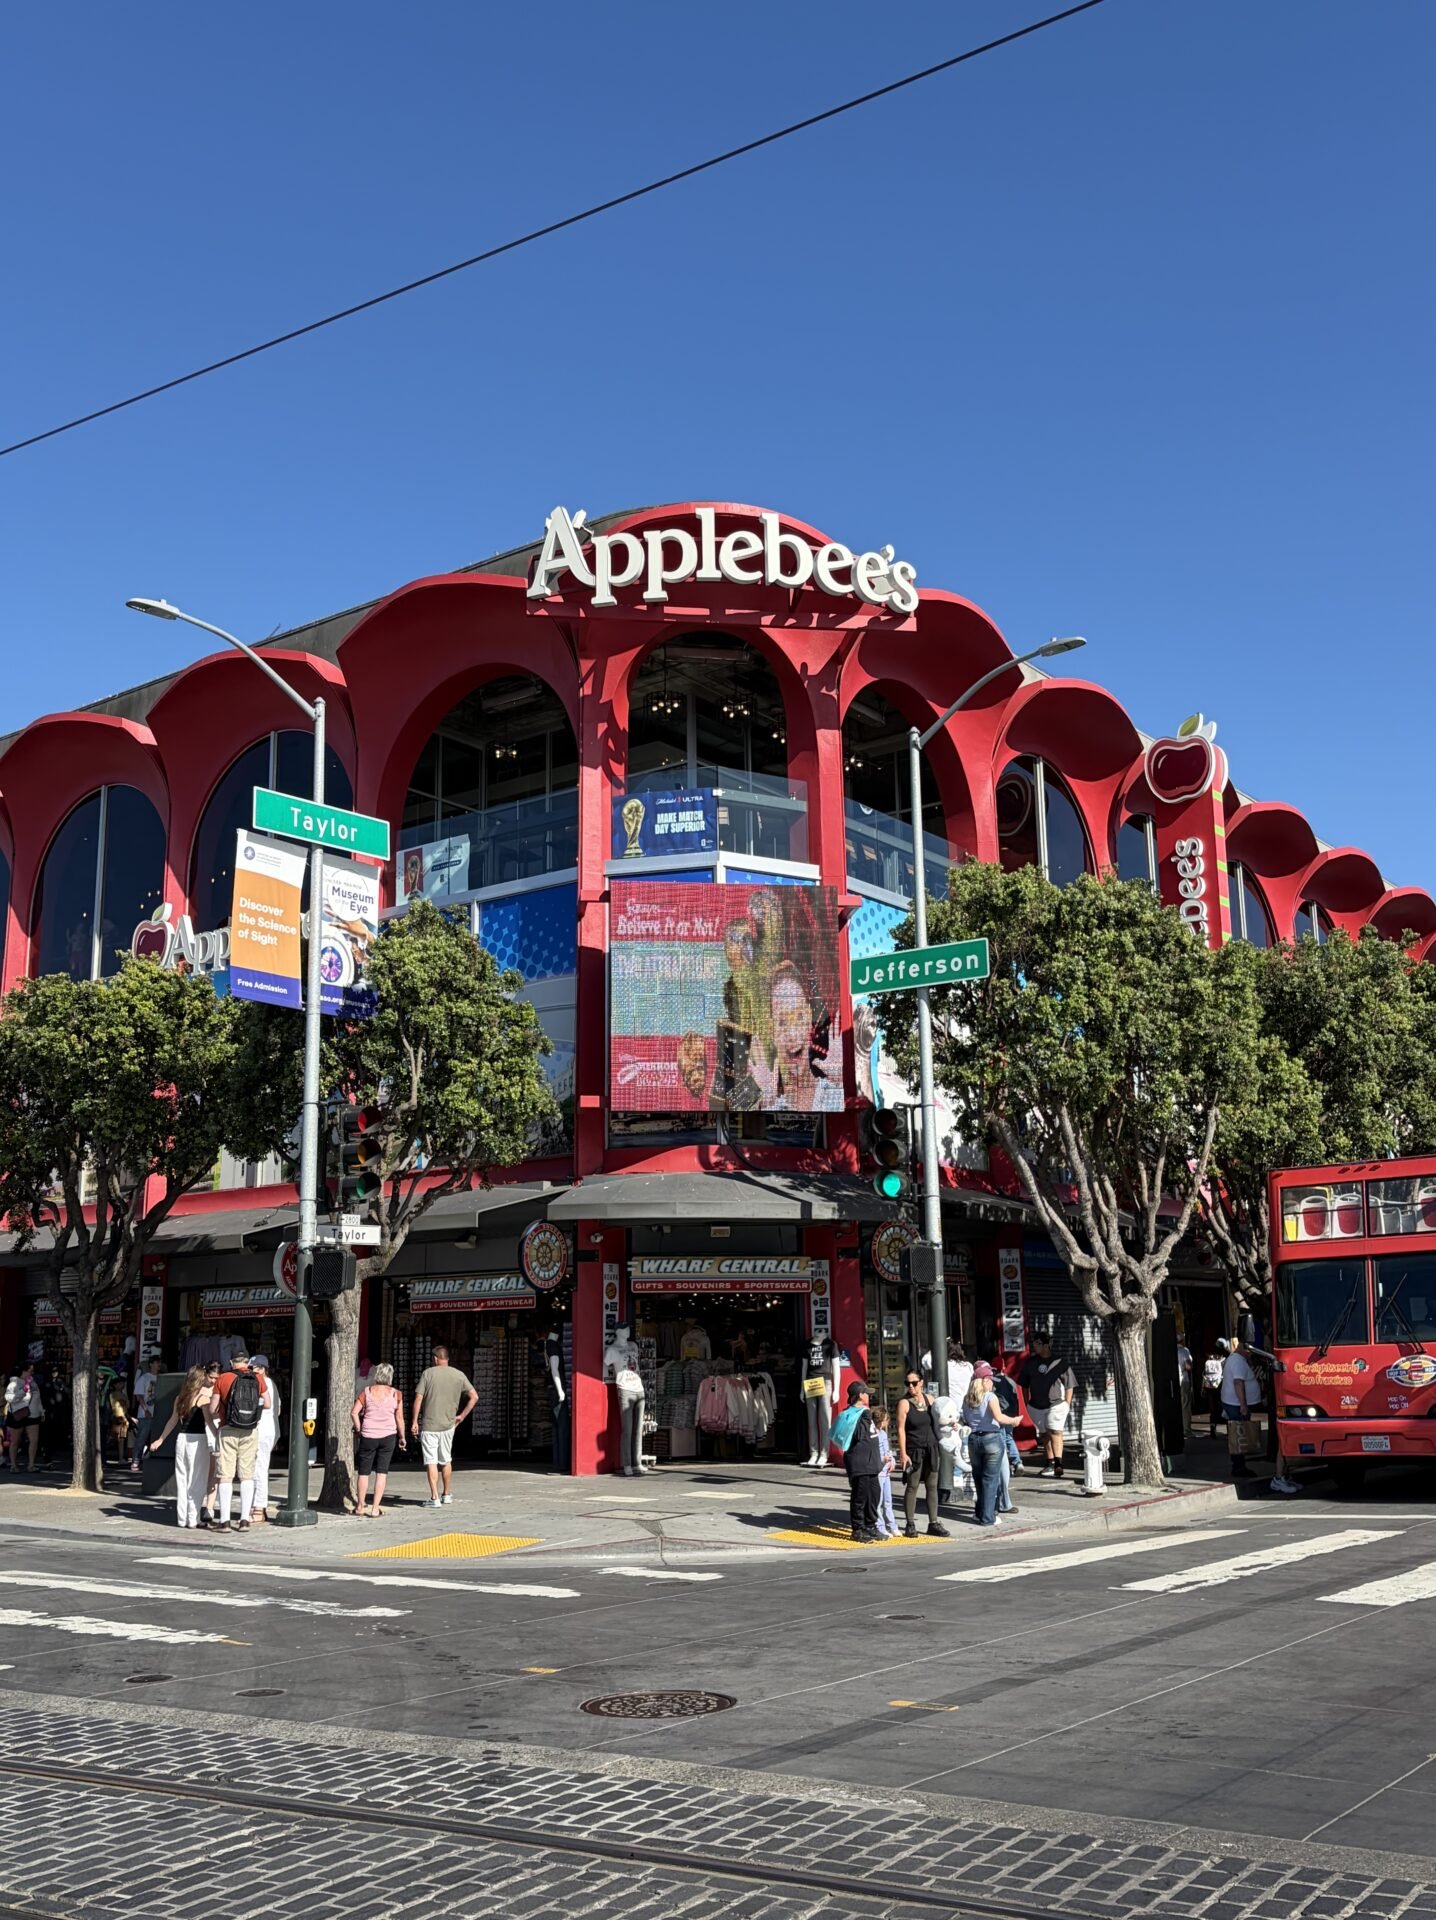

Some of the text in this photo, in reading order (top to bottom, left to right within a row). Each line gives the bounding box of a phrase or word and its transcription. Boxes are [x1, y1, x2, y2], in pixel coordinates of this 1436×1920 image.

[526, 506, 920, 614] Applebee's
[682, 795, 704, 803] ULTRA
[290, 806, 358, 842] Taylor
[657, 810, 704, 824] MAKE MATCH
[654, 821, 706, 835] DAY SUPERIOR
[332, 886, 374, 904] Museum
[239, 897, 284, 917] Discover
[350, 901, 368, 914] Eye
[238, 913, 297, 935] the Science
[238, 928, 278, 946] of Sight
[857, 954, 979, 985] Jefferson
[237, 978, 288, 995] Free Admission
[332, 1228, 366, 1242] Taylor
[532, 1231, 561, 1247] WHARF
[641, 1259, 801, 1273] WHARF CENTRAL
[414, 1276, 526, 1295] WHARF CENTRAL
[206, 1290, 247, 1304] WHARF
[486, 1299, 533, 1307] SPORTSWEAR
[1300, 1375, 1353, 1386] San Francisco
